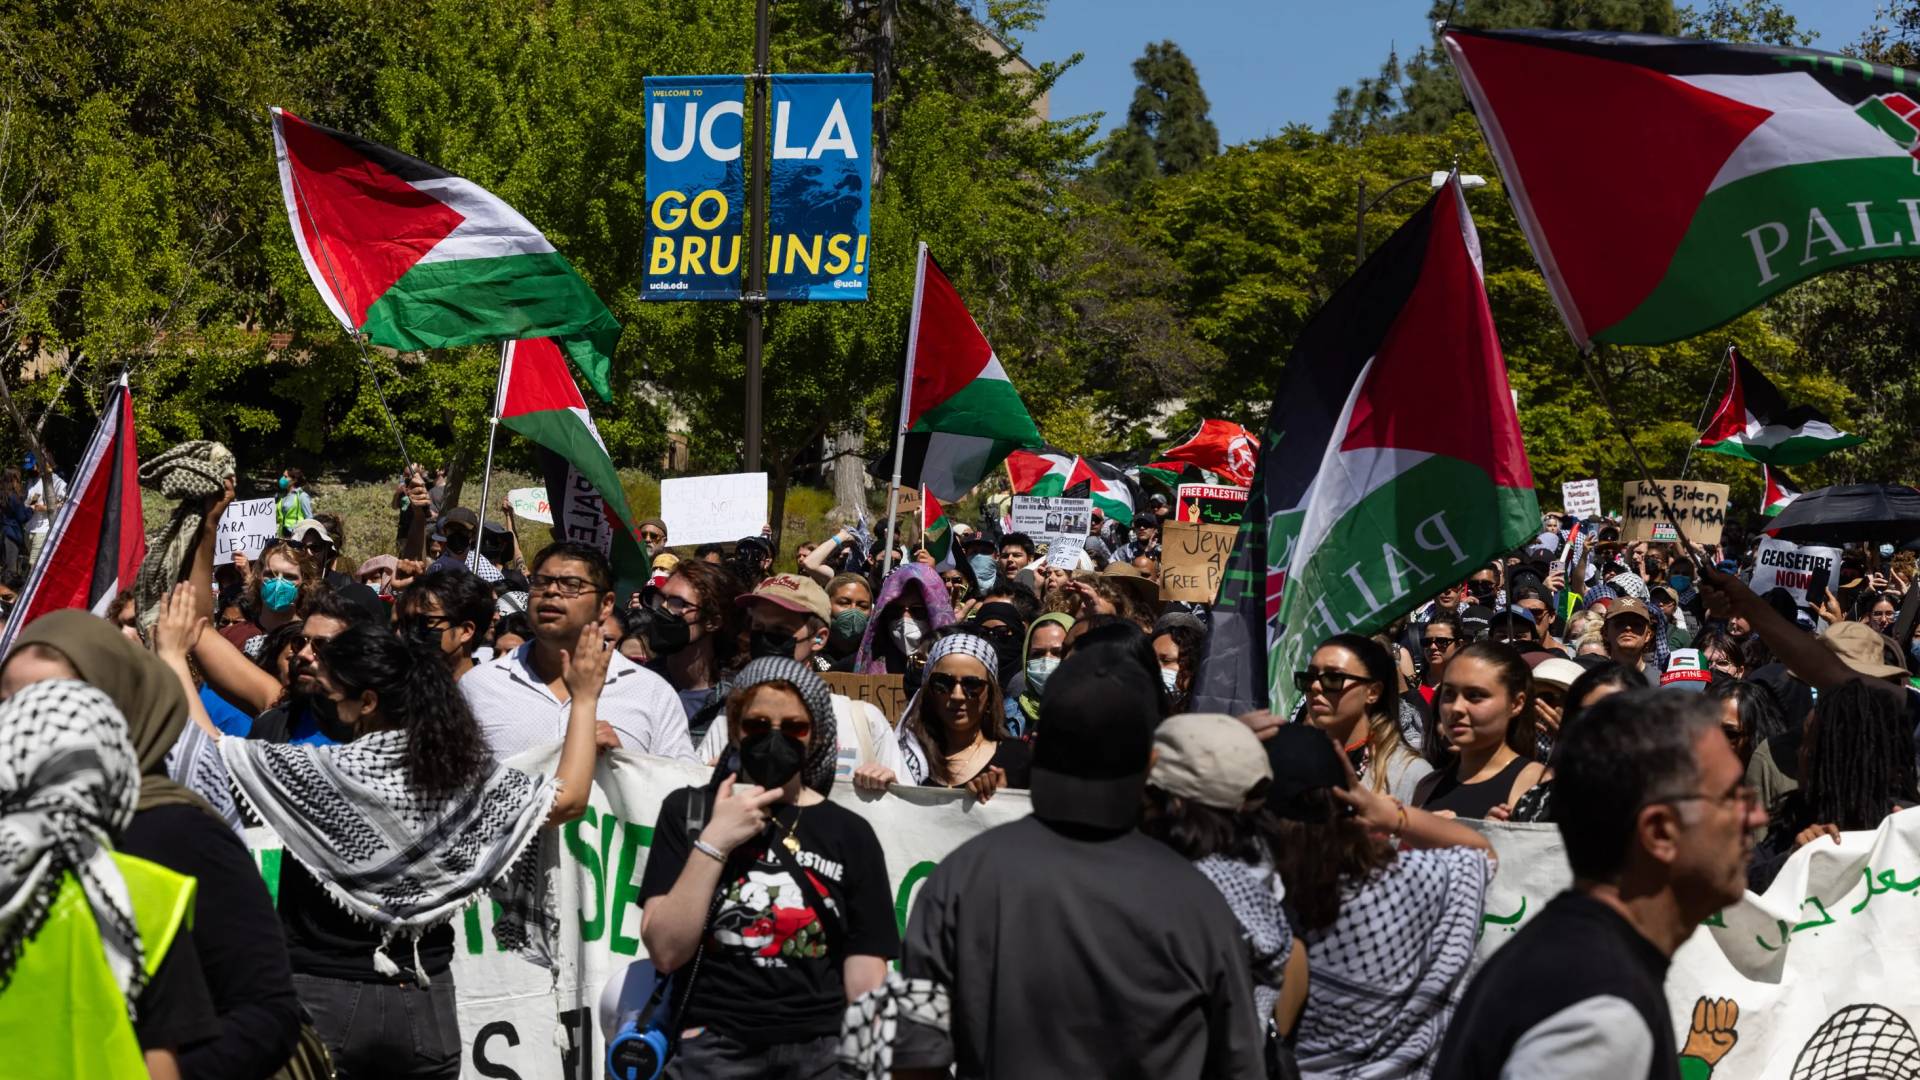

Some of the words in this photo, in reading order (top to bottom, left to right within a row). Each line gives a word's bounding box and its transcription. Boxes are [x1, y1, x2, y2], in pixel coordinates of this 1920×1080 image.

[651, 189, 729, 231] GO
[649, 281, 689, 290] ucla.edu
[833, 280, 862, 289] @ucla
[1181, 488, 1202, 496] FREE
[1204, 488, 1249, 500] PALESTINE
[1638, 481, 1667, 497] Fuck
[1673, 485, 1719, 504] Biden
[1203, 504, 1243, 523] حرية
[1626, 496, 1658, 520] Fuck
[1692, 506, 1723, 525] USA
[1207, 553, 1221, 571] 4
[1761, 549, 1832, 572] CEASEFIRE
[1162, 566, 1201, 590] FREE
[1776, 569, 1813, 590] NOW
